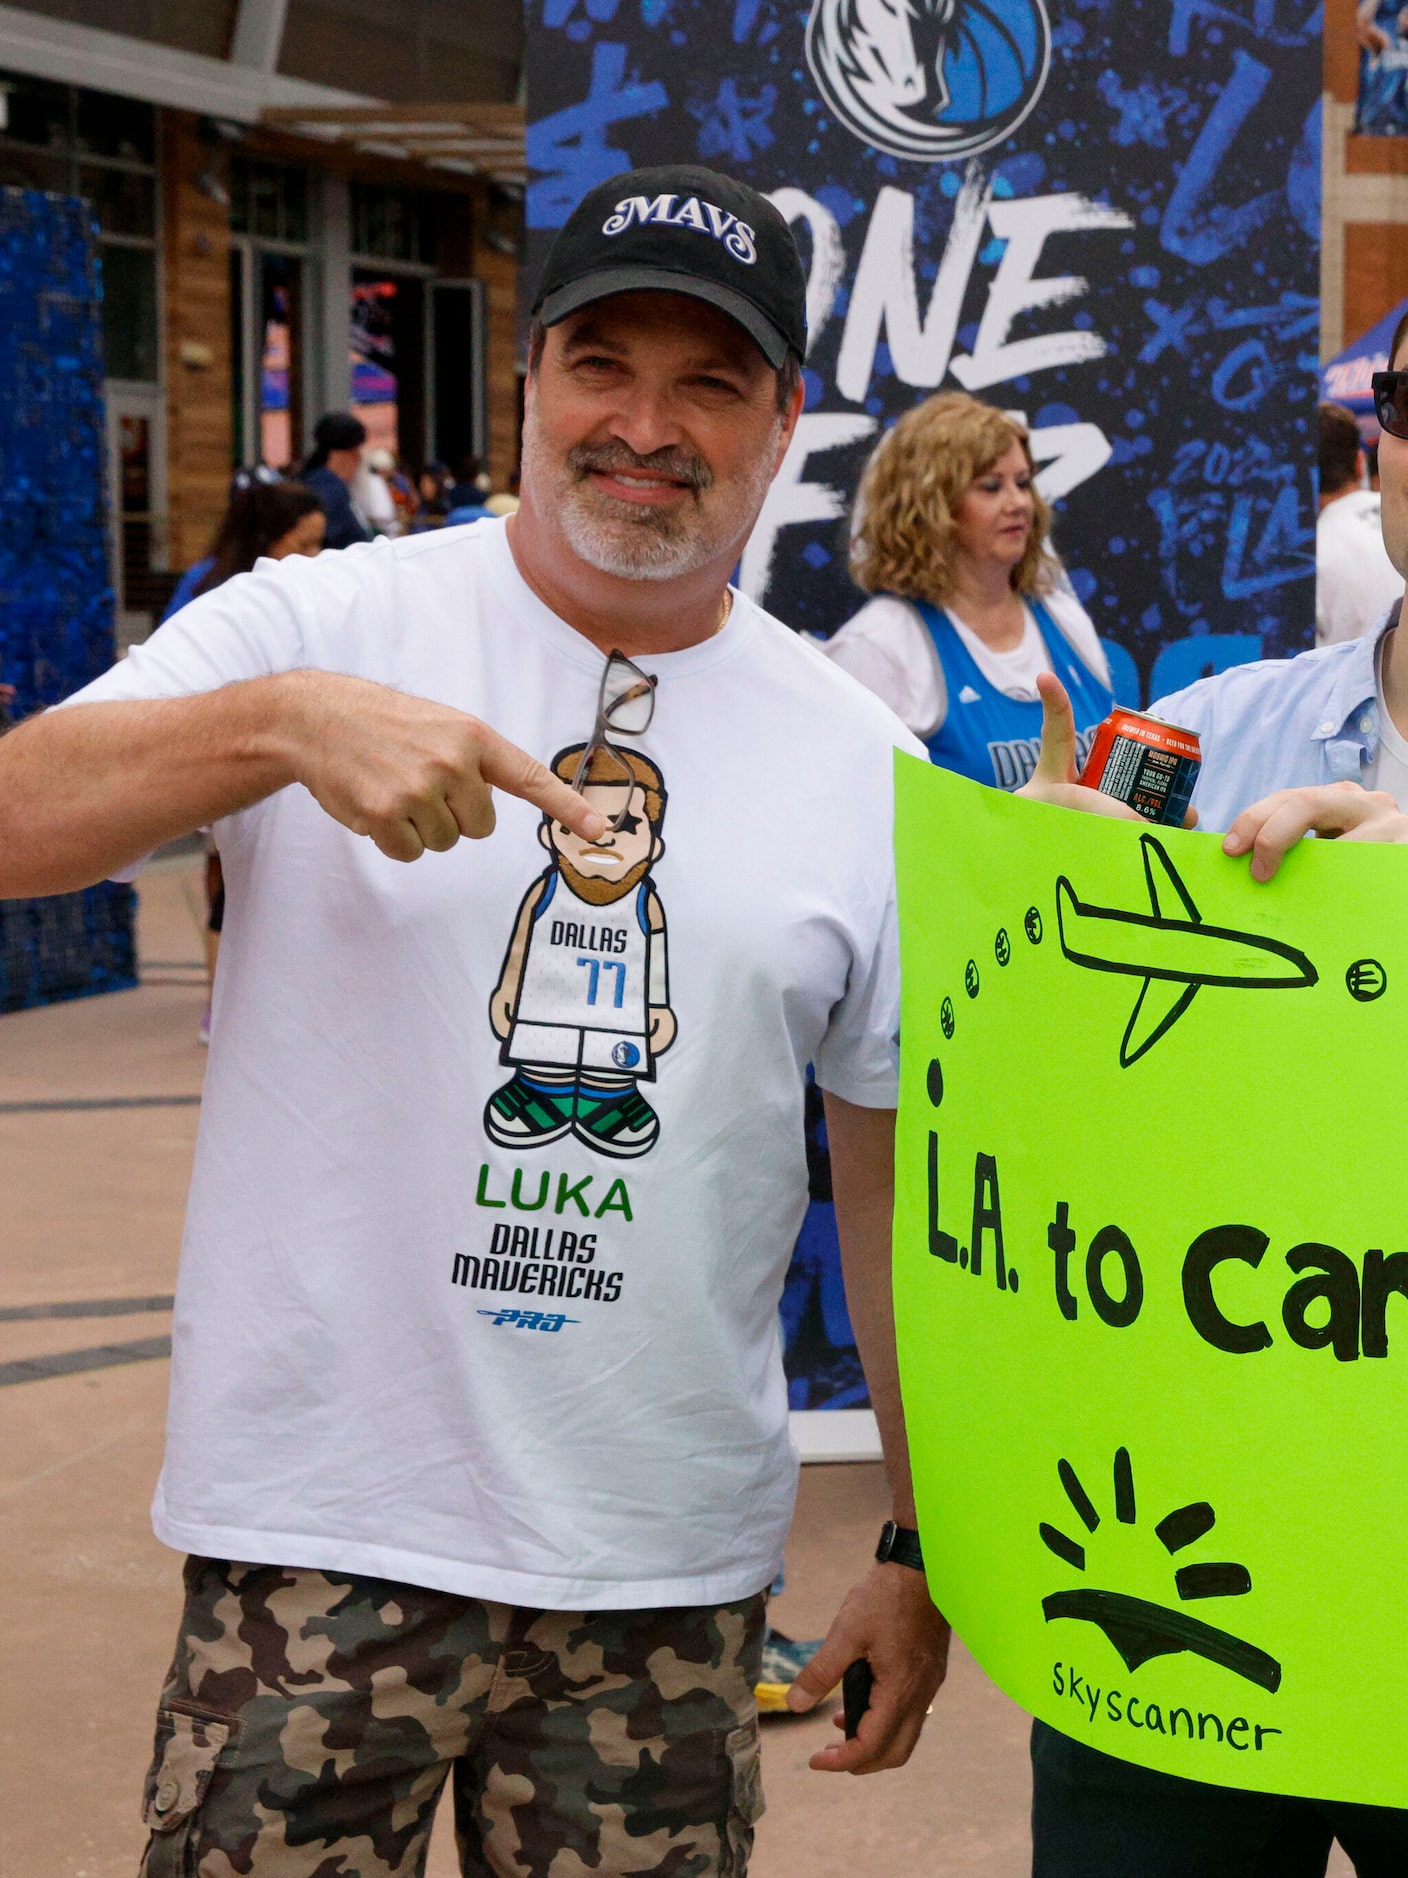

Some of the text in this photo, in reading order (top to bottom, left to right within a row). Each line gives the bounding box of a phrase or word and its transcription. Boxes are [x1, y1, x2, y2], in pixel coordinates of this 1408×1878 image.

[602, 193, 758, 266] MAVS
[1135, 803, 1156, 816] 8.6%
[549, 920, 628, 954] DALLAS
[576, 957, 628, 1009] 77
[475, 1163, 634, 1222] LUKA
[490, 1223, 598, 1264] DALLAS
[927, 1130, 1019, 1294] L.A.
[1047, 1201, 1145, 1329] to
[451, 1252, 624, 1303] MAVERICKS
